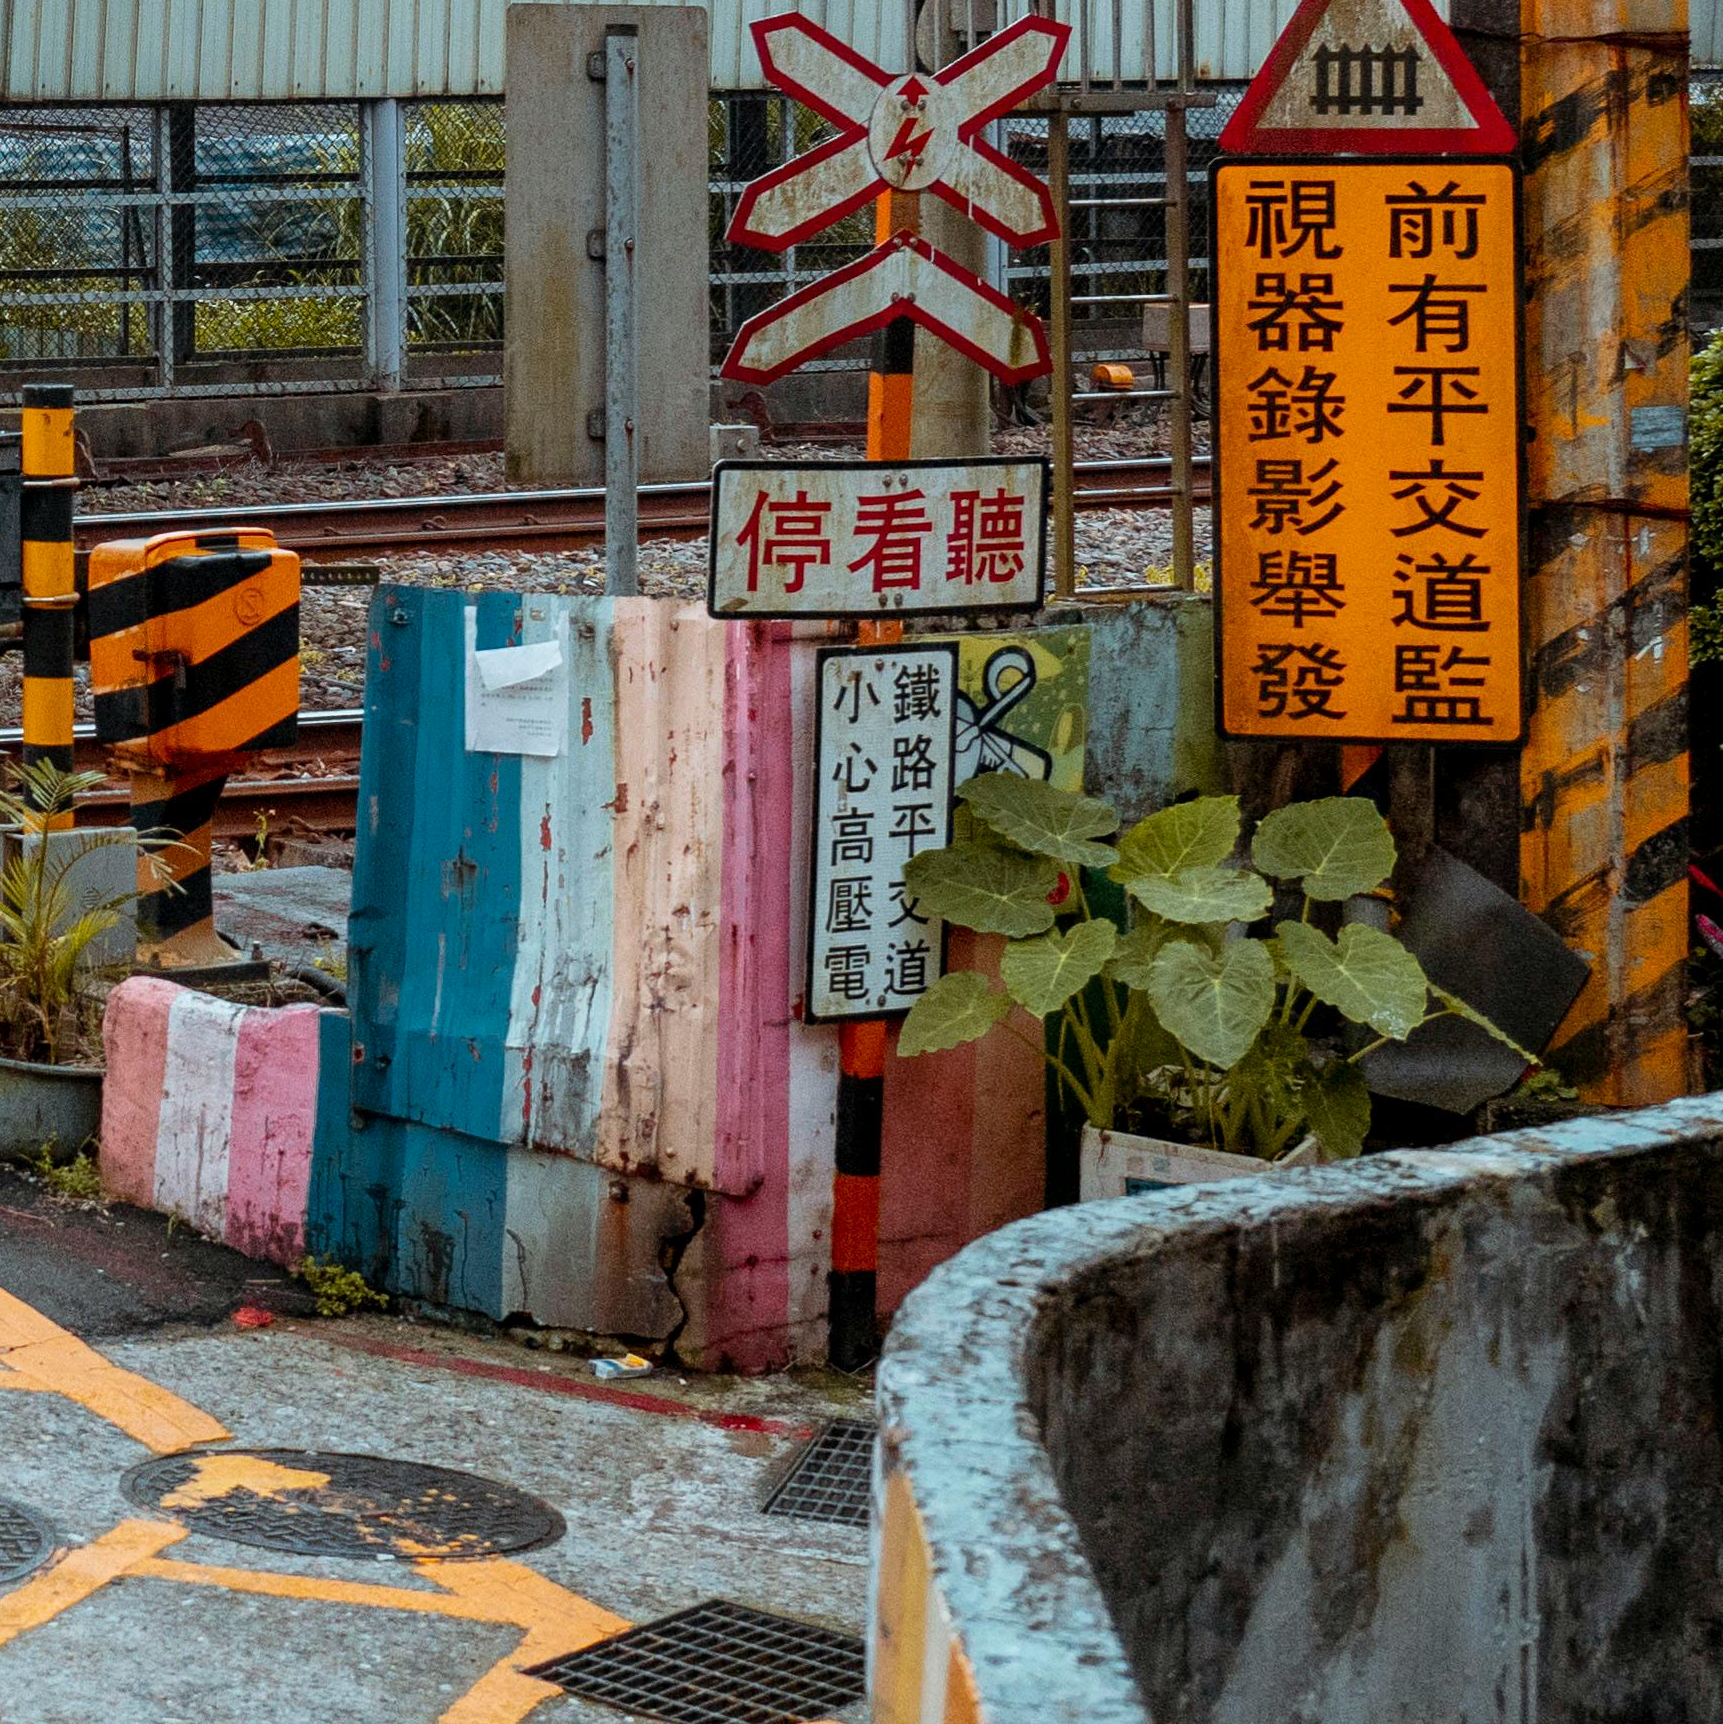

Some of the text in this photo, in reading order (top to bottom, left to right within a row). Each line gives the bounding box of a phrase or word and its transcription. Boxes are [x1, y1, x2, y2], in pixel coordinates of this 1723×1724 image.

[735, 487, 1027, 596] 停看聽
[1243, 178, 1348, 722] 視器錄影舉發
[1385, 180, 1496, 728] 前有平交道監
[824, 670, 881, 1001] 小心高壓電
